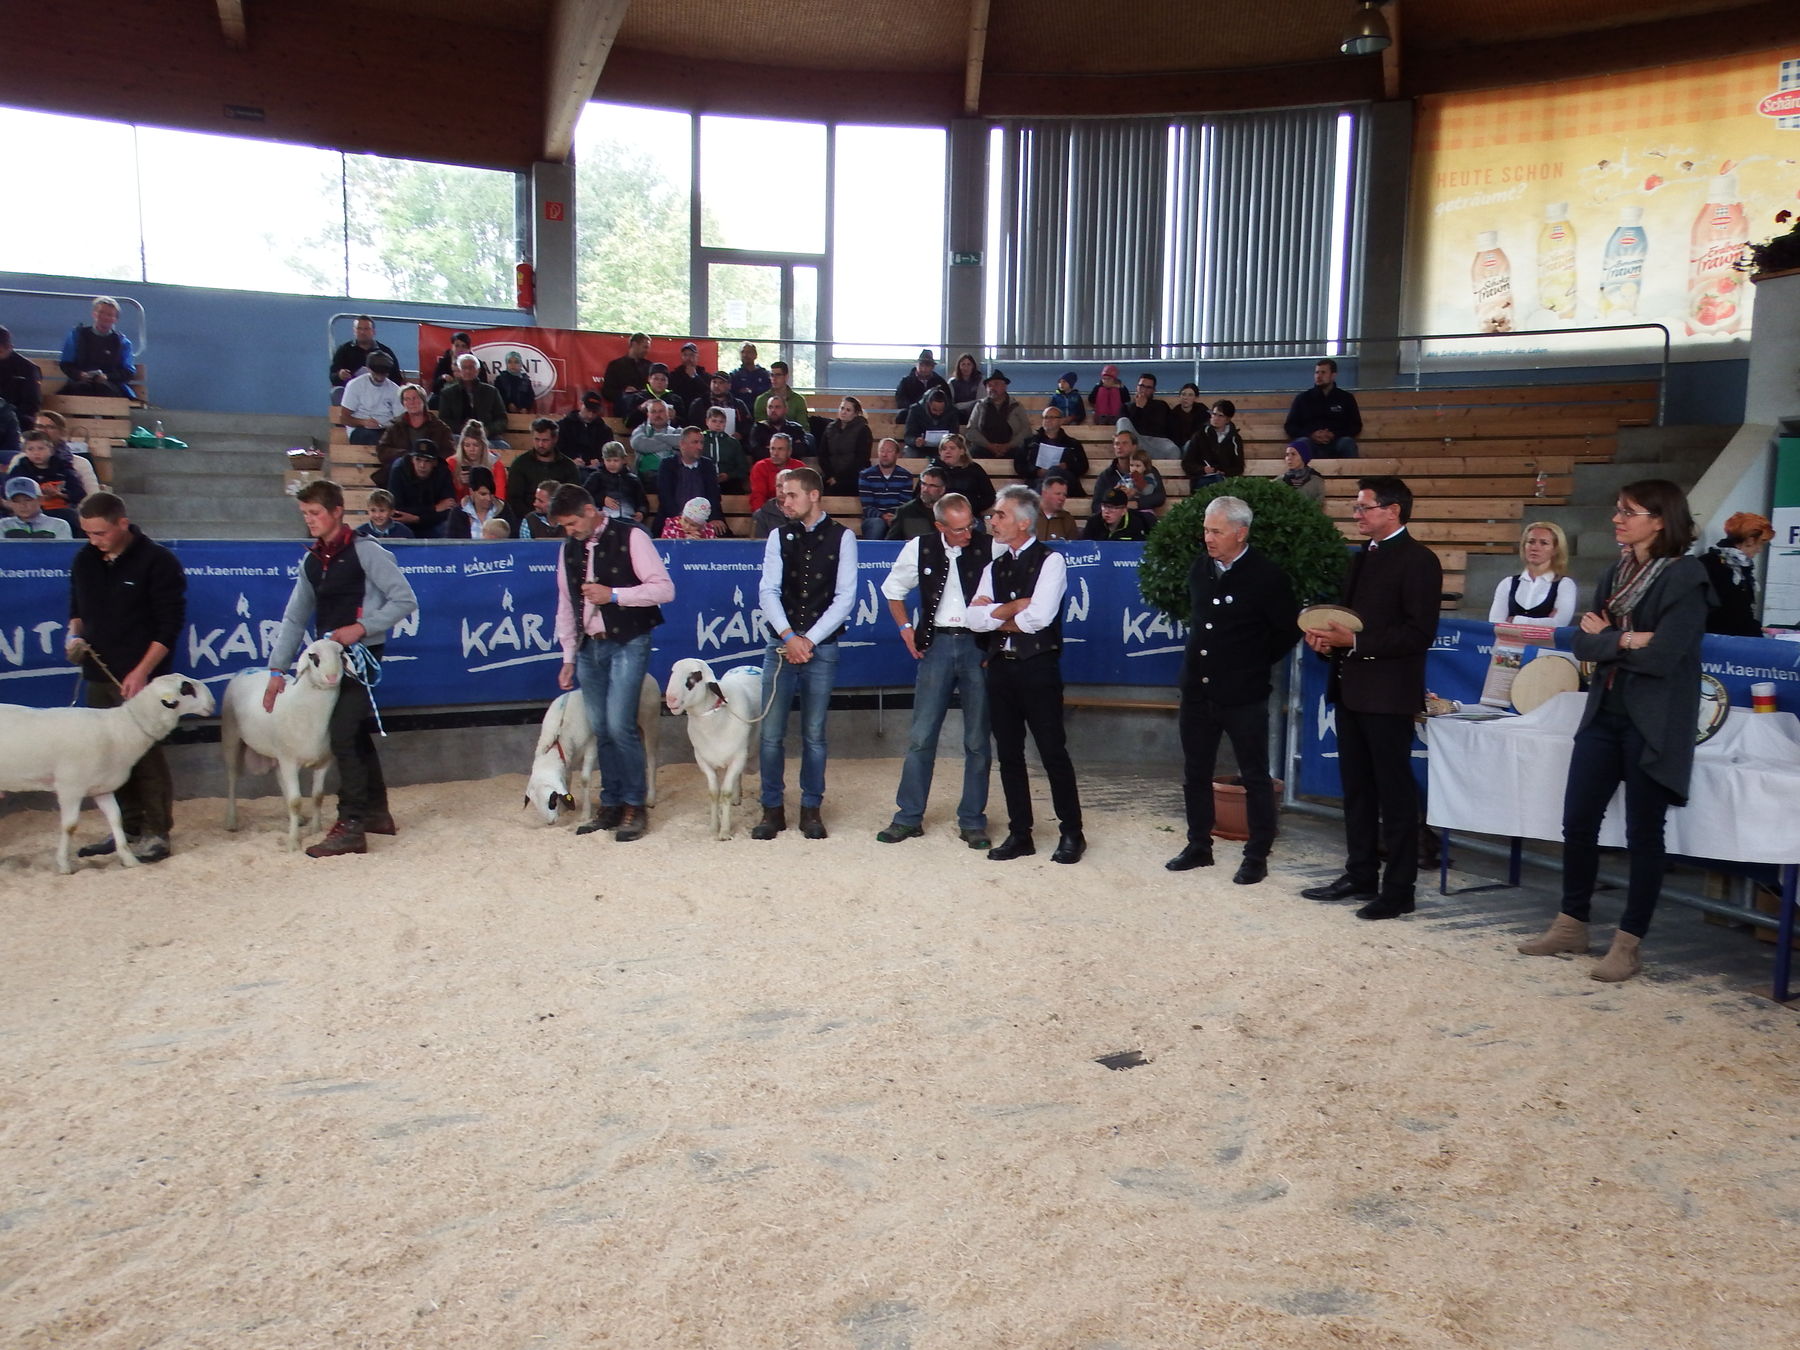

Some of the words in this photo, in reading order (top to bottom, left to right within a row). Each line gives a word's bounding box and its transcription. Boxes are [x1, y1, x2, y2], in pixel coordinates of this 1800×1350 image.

[1436, 168, 1493, 188] HEUTE
[1502, 162, 1564, 183] SCHON
[683, 561, 764, 571] www.kaernten.a
